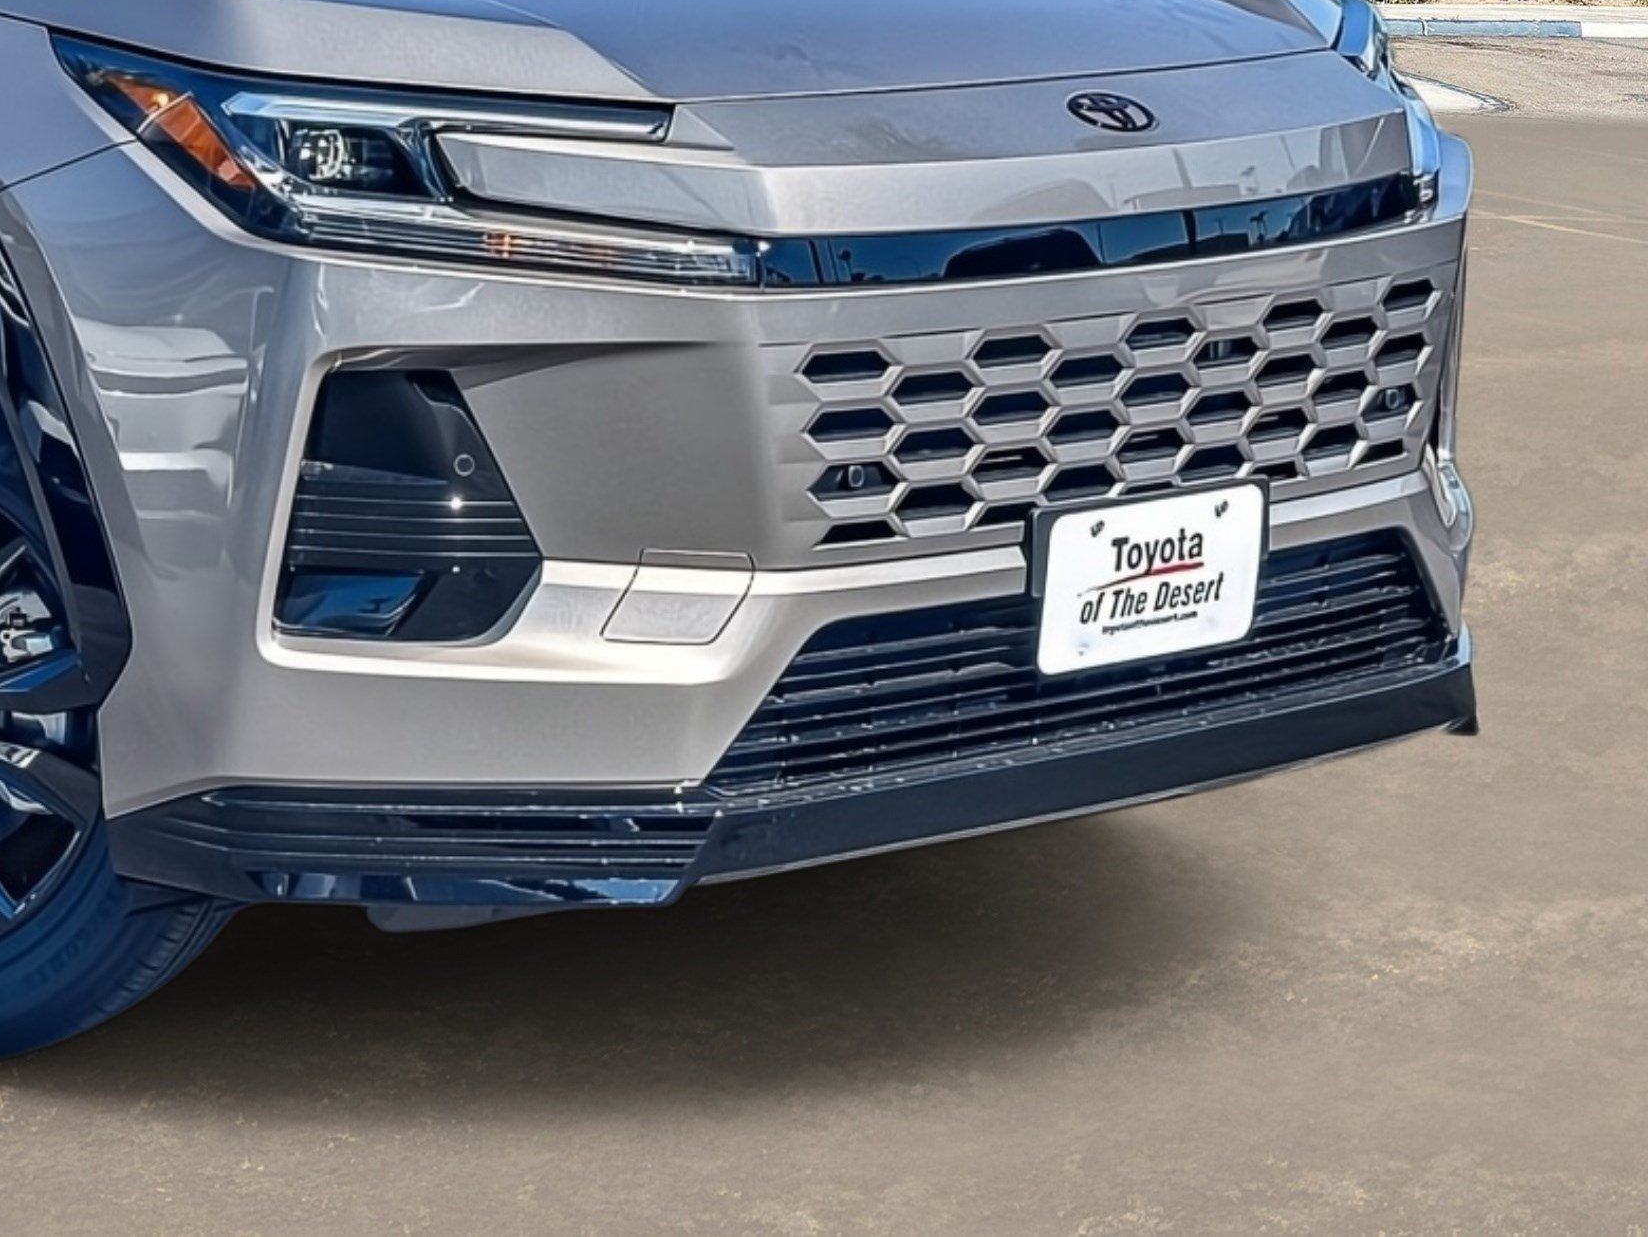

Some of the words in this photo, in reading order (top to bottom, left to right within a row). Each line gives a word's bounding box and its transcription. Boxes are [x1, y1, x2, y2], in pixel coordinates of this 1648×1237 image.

[1111, 528, 1203, 574] Toyota
[1079, 592, 1105, 624] of
[1109, 589, 1148, 620] The
[1153, 572, 1224, 611] Desert
